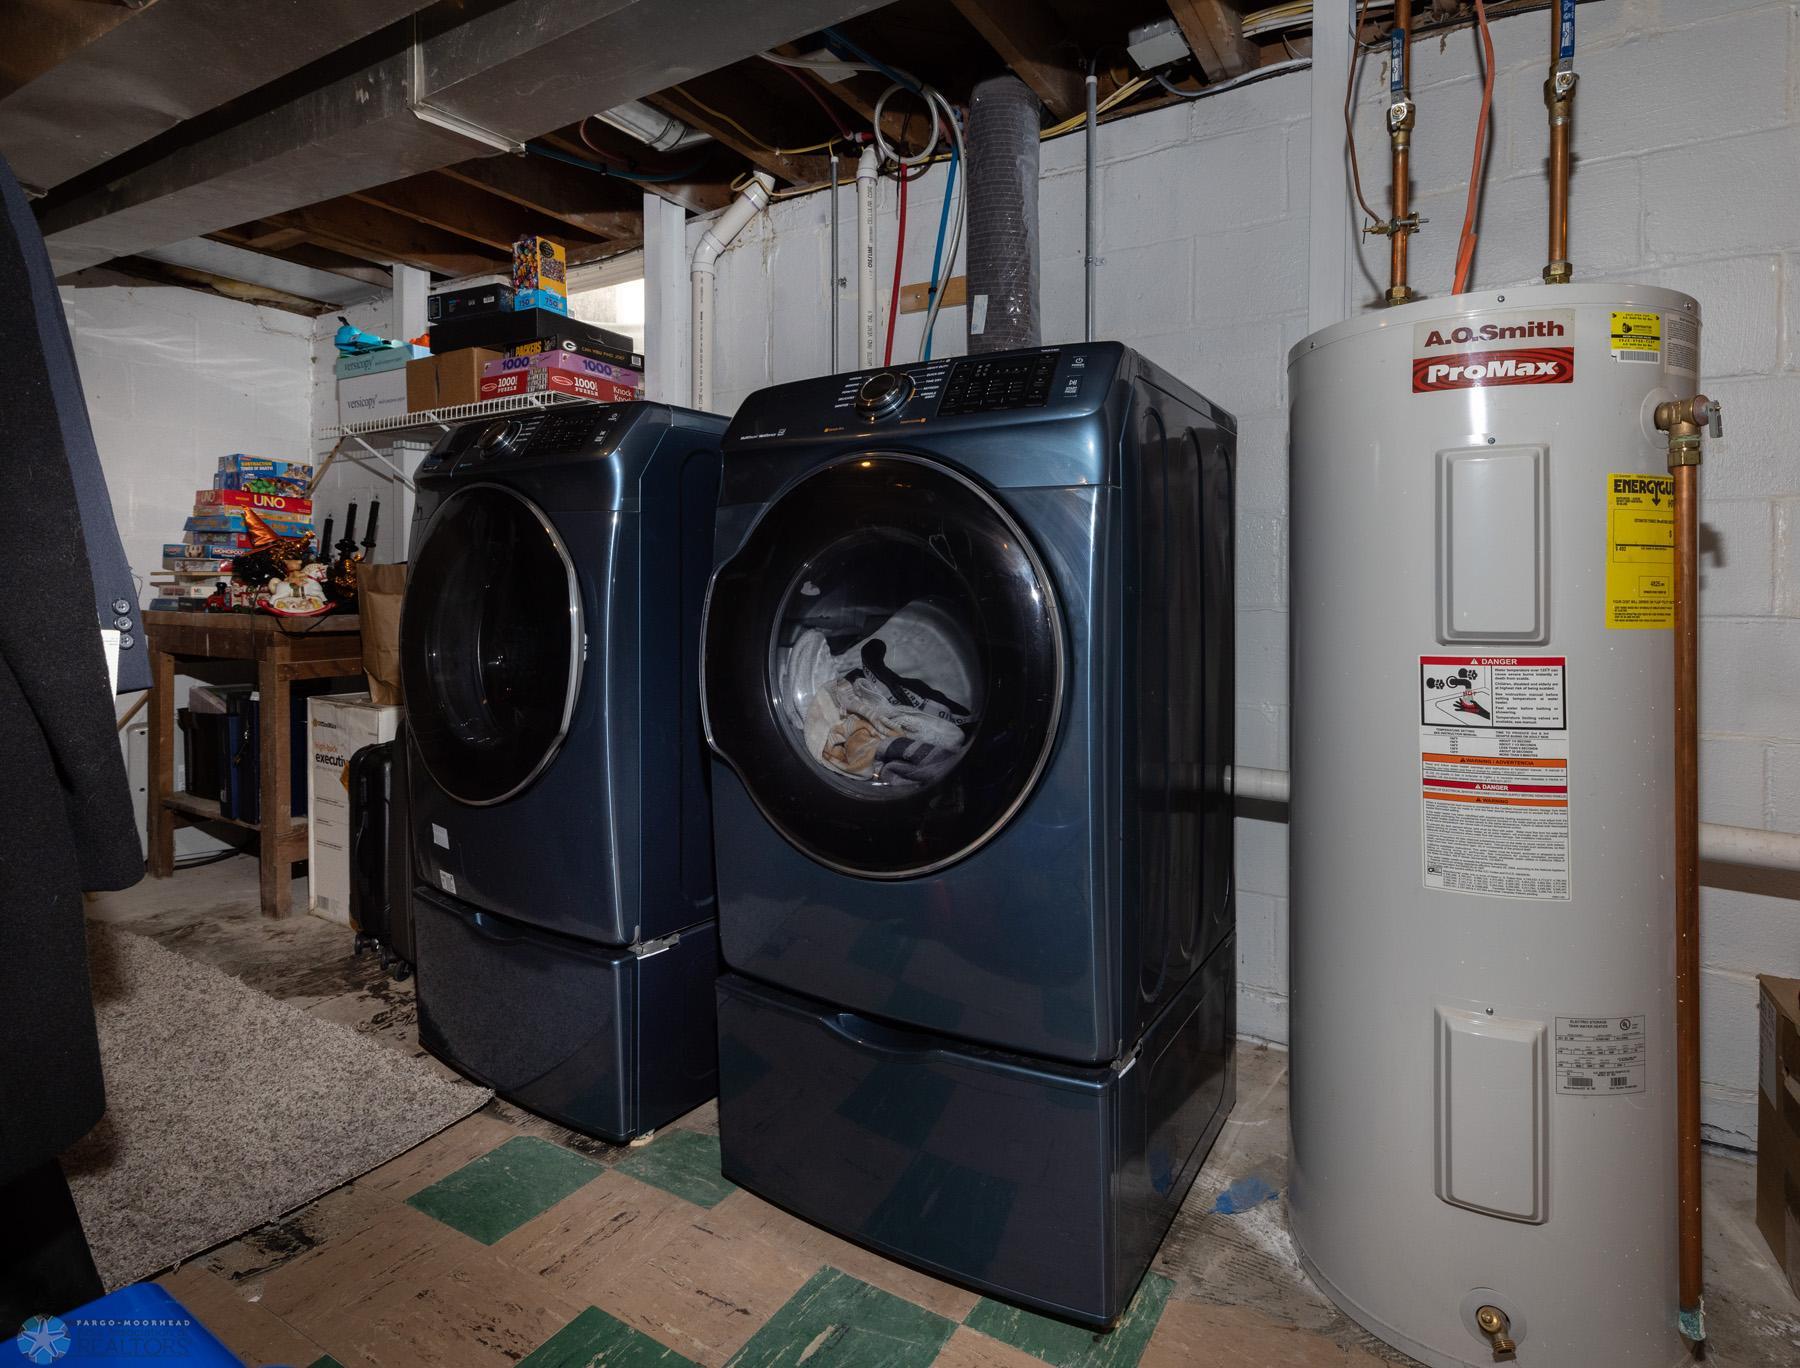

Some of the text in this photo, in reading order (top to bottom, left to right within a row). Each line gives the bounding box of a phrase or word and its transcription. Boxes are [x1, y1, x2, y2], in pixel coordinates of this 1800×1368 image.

[502, 356, 530, 370] 1000
[584, 359, 612, 376] 1000
[1427, 359, 1558, 384] ProMax
[613, 386, 632, 397] Knock
[347, 396, 376, 409] versicopy
[254, 494, 286, 509] UNO
